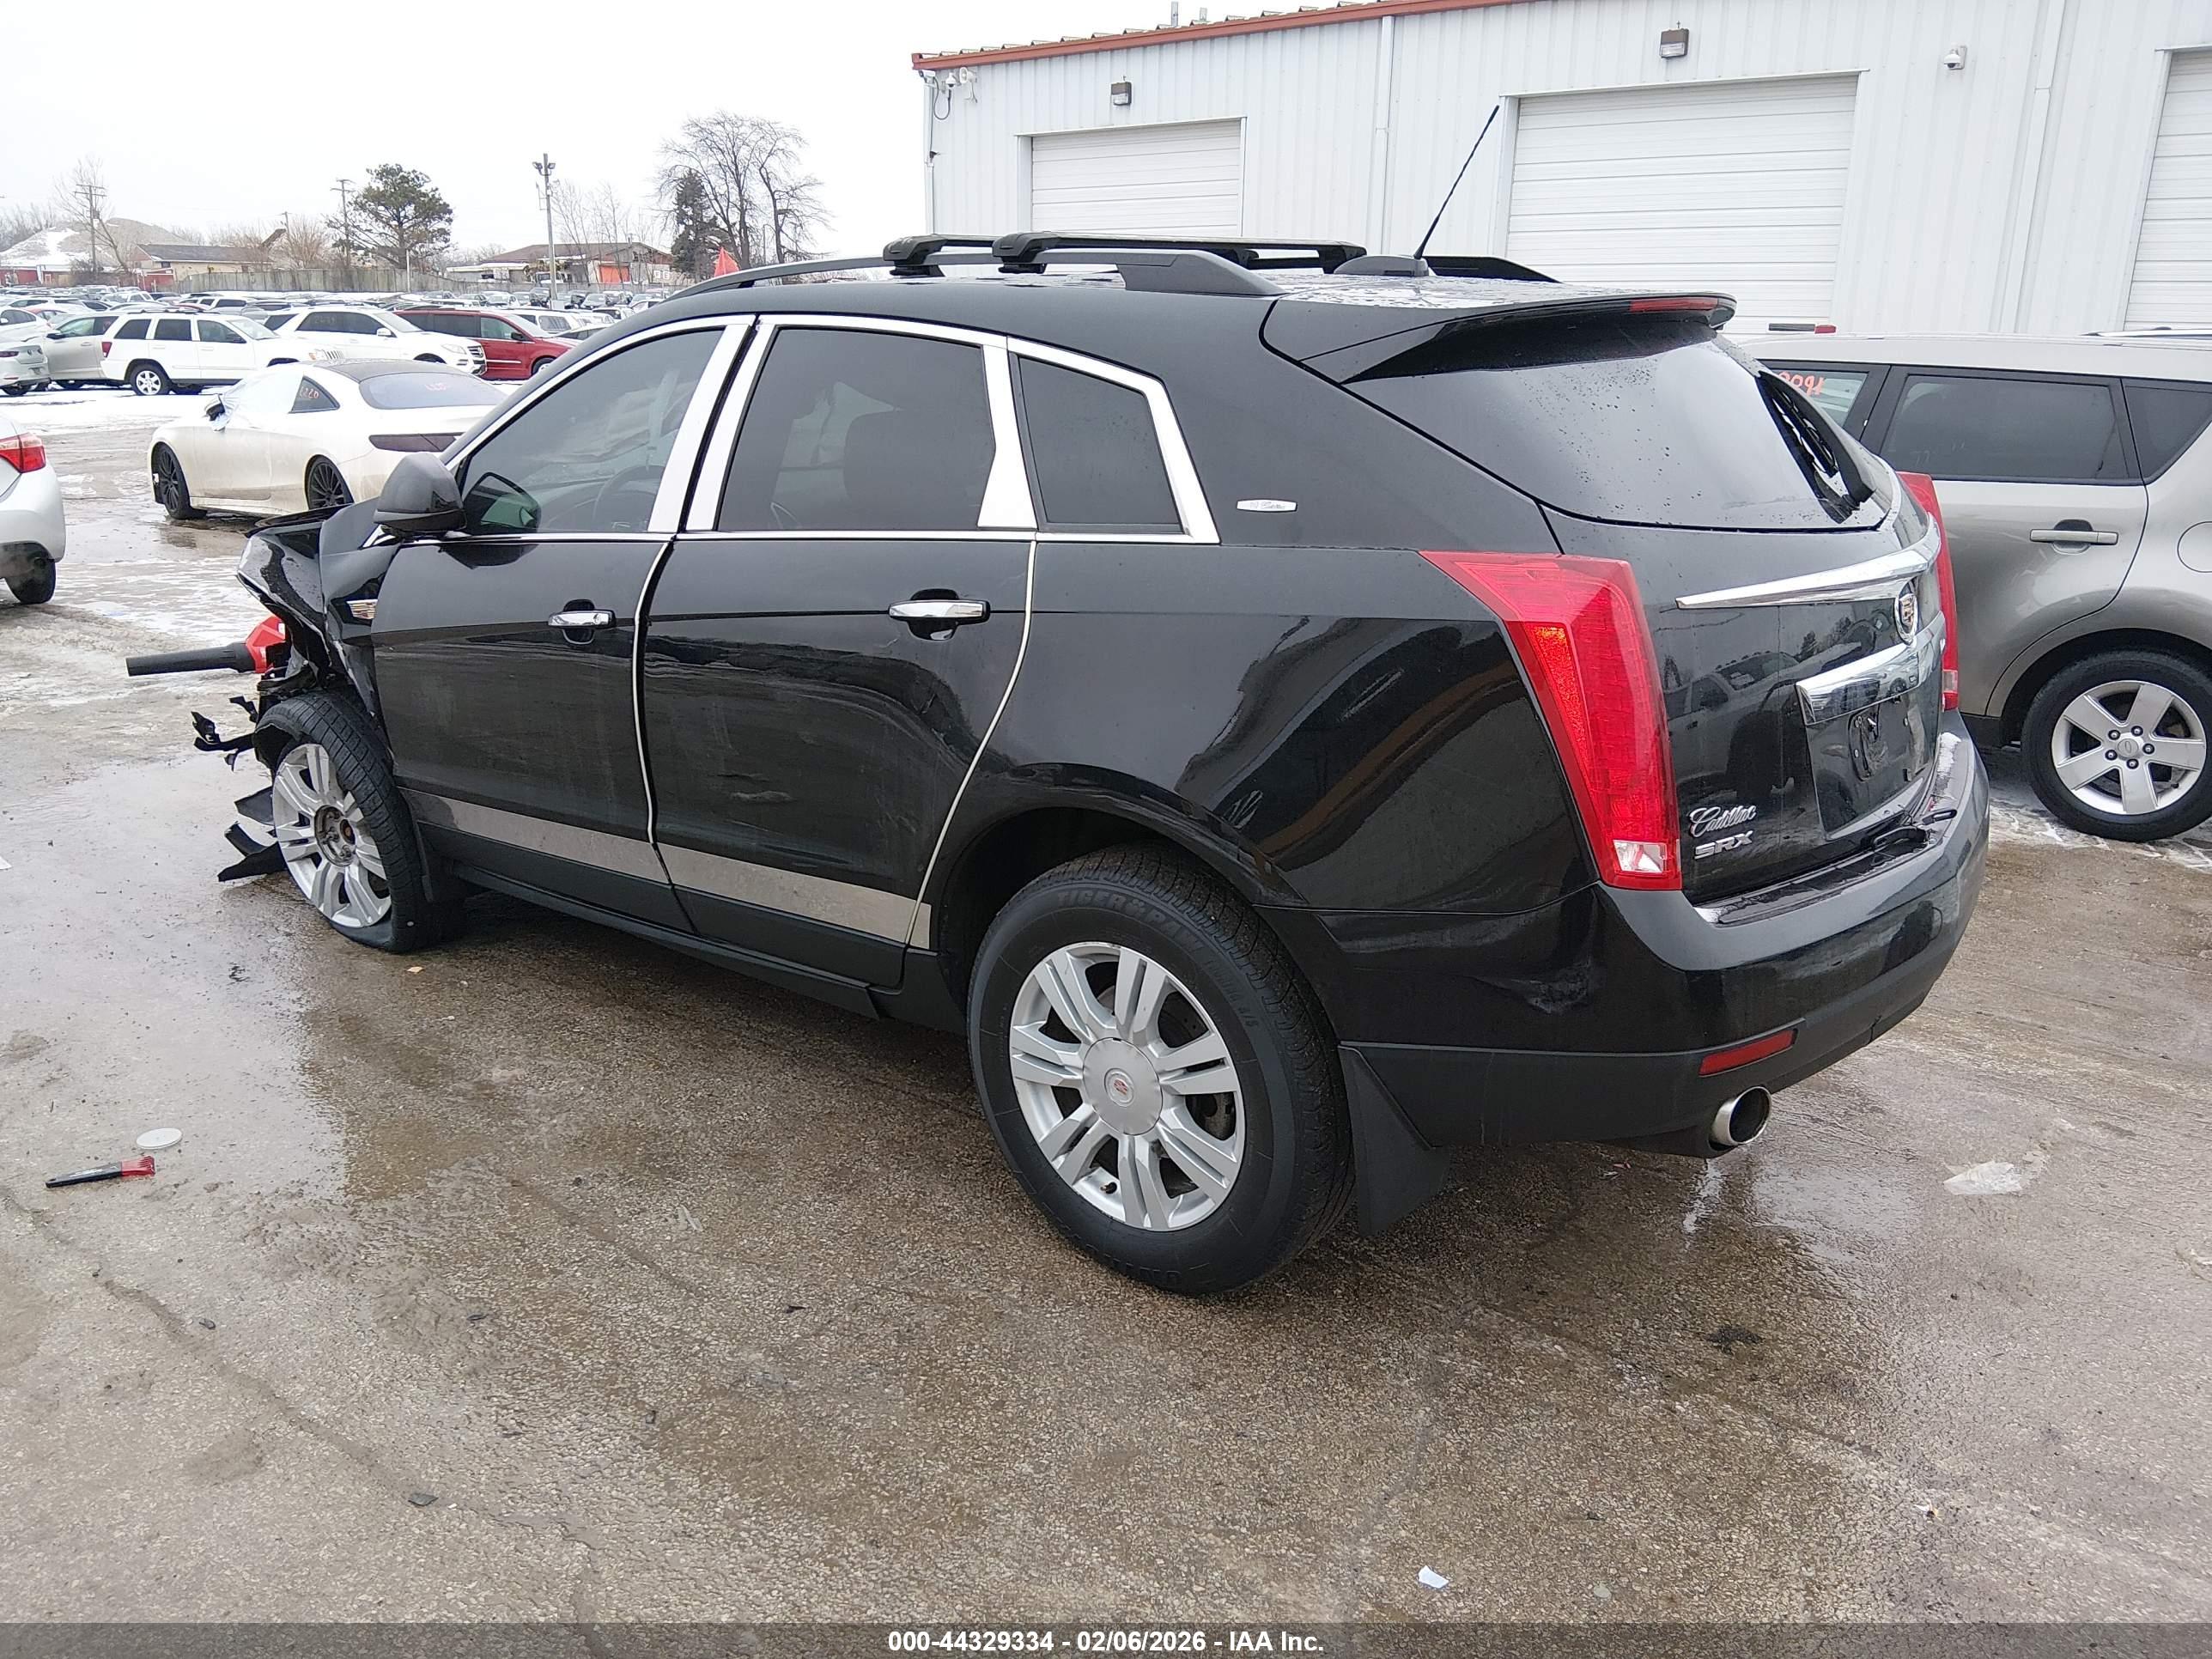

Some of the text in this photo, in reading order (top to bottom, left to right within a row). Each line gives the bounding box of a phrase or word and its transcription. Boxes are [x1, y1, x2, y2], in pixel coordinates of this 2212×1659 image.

[1689, 805, 1757, 838] Cadillac
[1694, 830, 1753, 860] SRX
[1057, 890, 1127, 912] TIGER
